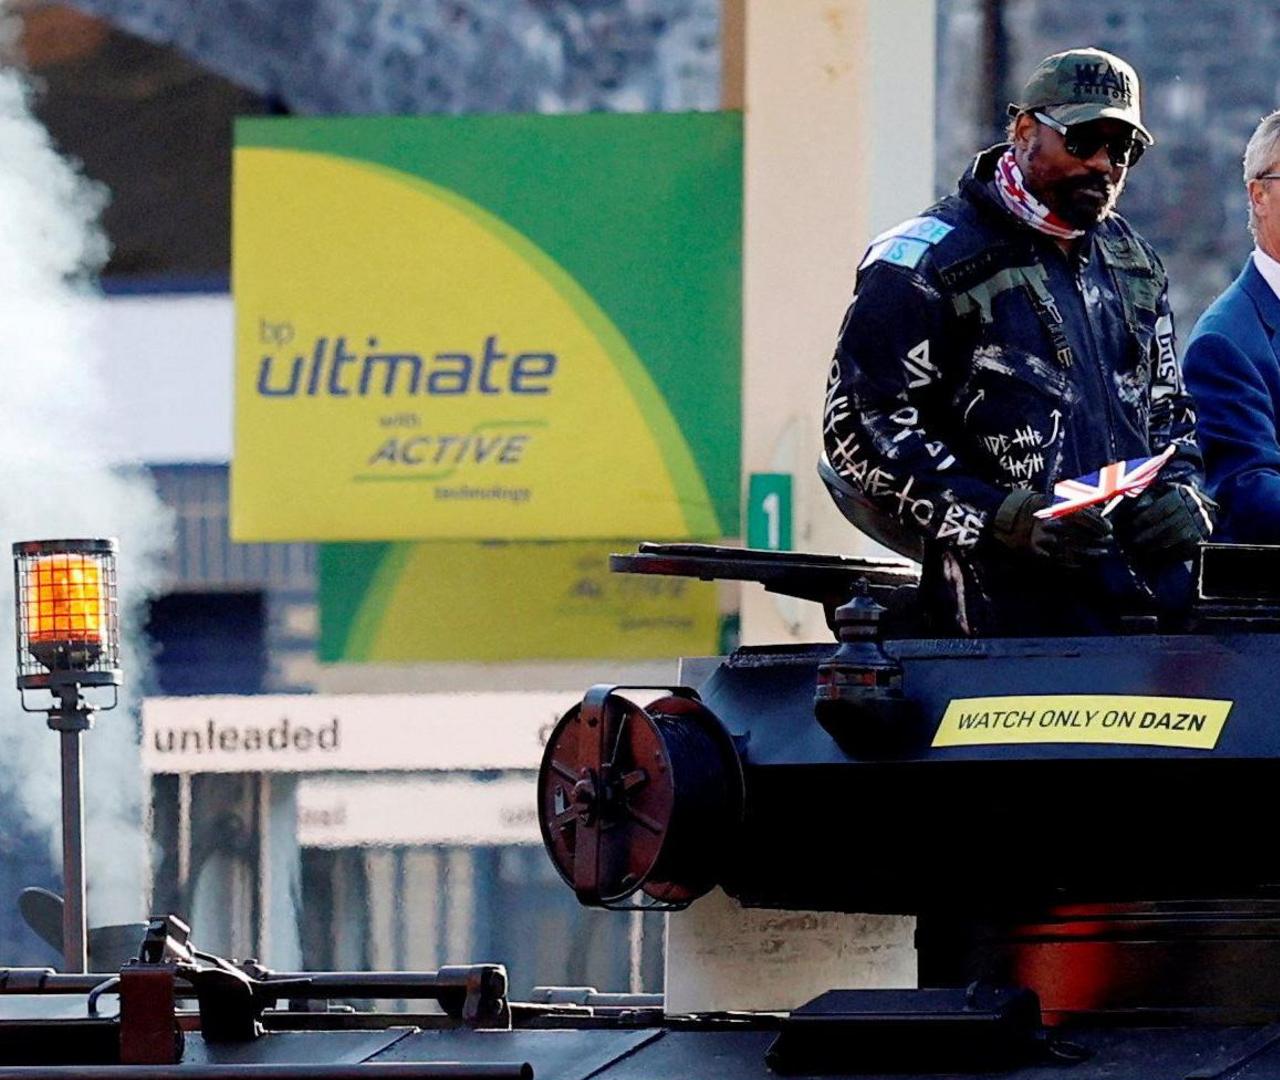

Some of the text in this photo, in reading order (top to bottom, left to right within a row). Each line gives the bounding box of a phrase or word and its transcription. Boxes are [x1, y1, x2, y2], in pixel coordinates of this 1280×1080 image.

[259, 319, 295, 346] bp
[256, 334, 558, 396] ultimate
[366, 433, 533, 466] ACTIVE
[760, 492, 781, 534] 1
[154, 717, 341, 753] unleaded
[957, 710, 1207, 732] WATCH ONLY ON DAZN
